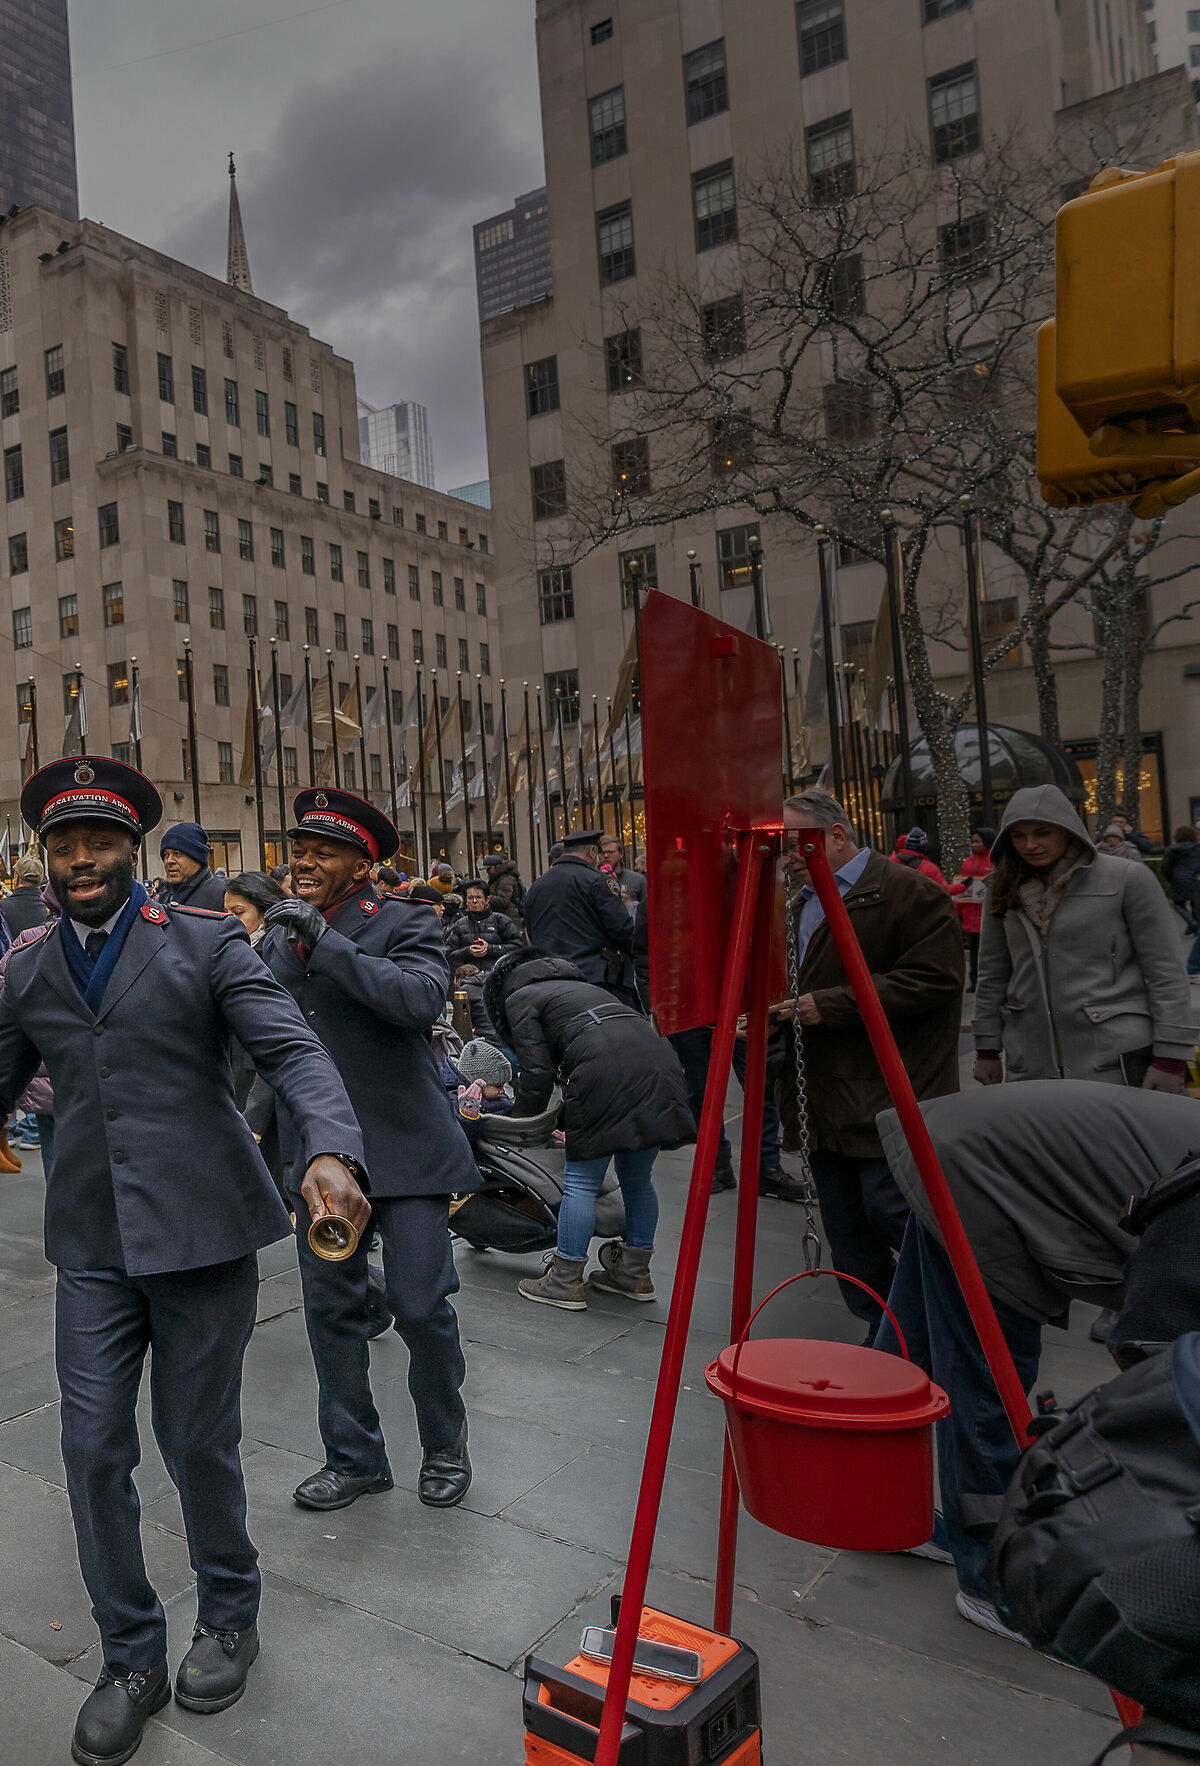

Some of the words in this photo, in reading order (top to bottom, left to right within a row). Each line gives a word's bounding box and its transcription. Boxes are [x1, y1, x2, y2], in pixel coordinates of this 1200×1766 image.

[55, 794, 109, 806] SALVATION
[111, 798, 132, 814] ARMY
[336, 818, 359, 833] ARMY
[364, 901, 375, 911] S
[148, 907, 160, 919] S
